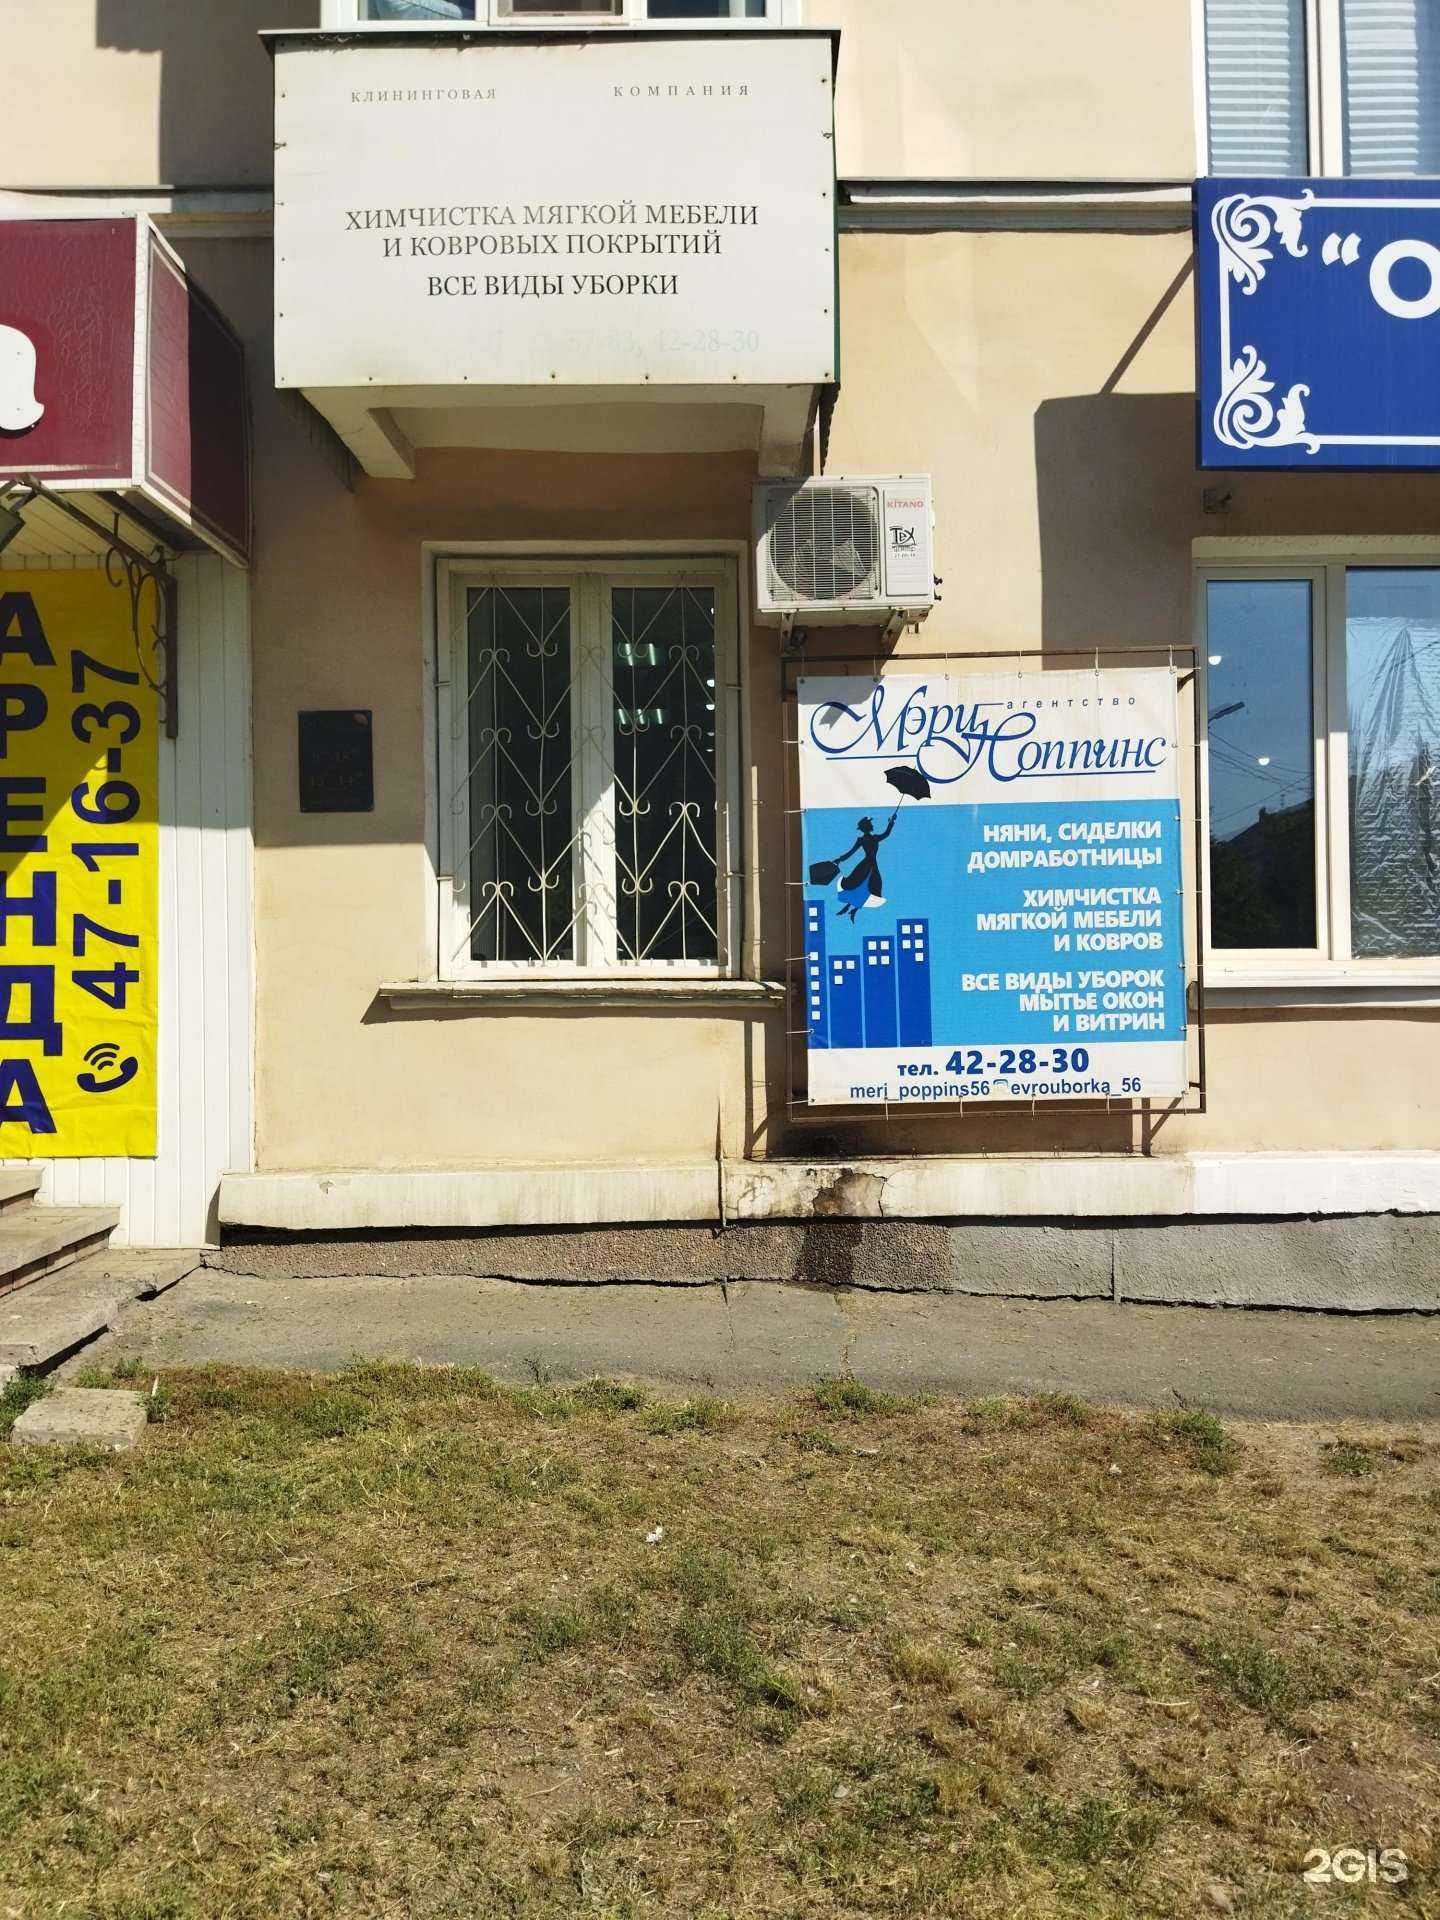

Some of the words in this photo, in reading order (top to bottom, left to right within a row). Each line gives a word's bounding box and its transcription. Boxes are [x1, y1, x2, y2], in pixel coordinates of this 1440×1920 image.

[350, 88, 497, 103] КЛИНИНГОВАЯ
[613, 85, 751, 98] КОМПАНИЯ
[344, 206, 516, 231] ХИМЧИСТКА
[522, 201, 637, 225] МЯГКОЙ
[645, 205, 760, 225] МЕБЕЛИ
[382, 237, 402, 258] И
[410, 233, 559, 256] КОВРОВЫХ
[567, 229, 722, 255] ПОКРЫТИЙ
[427, 275, 478, 297] ВСЕ
[485, 274, 564, 299] ВИДЫ
[572, 273, 679, 296] УБОРКИ
[1006, 696, 1136, 710] агентство
[71, 650, 141, 1009] 47-16-37
[983, 824, 1052, 843] НЯНИ,
[1058, 821, 1162, 844] СИДЕЛКИ
[967, 847, 1162, 873] ДОМРАБОТНИЦЫ
[1023, 887, 1162, 907] ХИМЧИСТКА
[976, 906, 1067, 931] МЯГКОЙ
[1073, 909, 1162, 929] МЕБЕЛИ
[1053, 934, 1070, 951] И
[1076, 932, 1163, 951] КОВРОВ
[961, 973, 1000, 992] ВСЕ
[1005, 971, 1073, 994] ВИДЫ
[1077, 969, 1165, 989] УБОРОК
[1019, 992, 1097, 1012] МЫТЬЕ
[1102, 991, 1164, 1010] ОКОН
[1053, 1014, 1070, 1032] И
[1075, 1012, 1165, 1032] ВИТРИН
[897, 1063, 939, 1077] тел.
[945, 1047, 1090, 1076] 42-28-30
